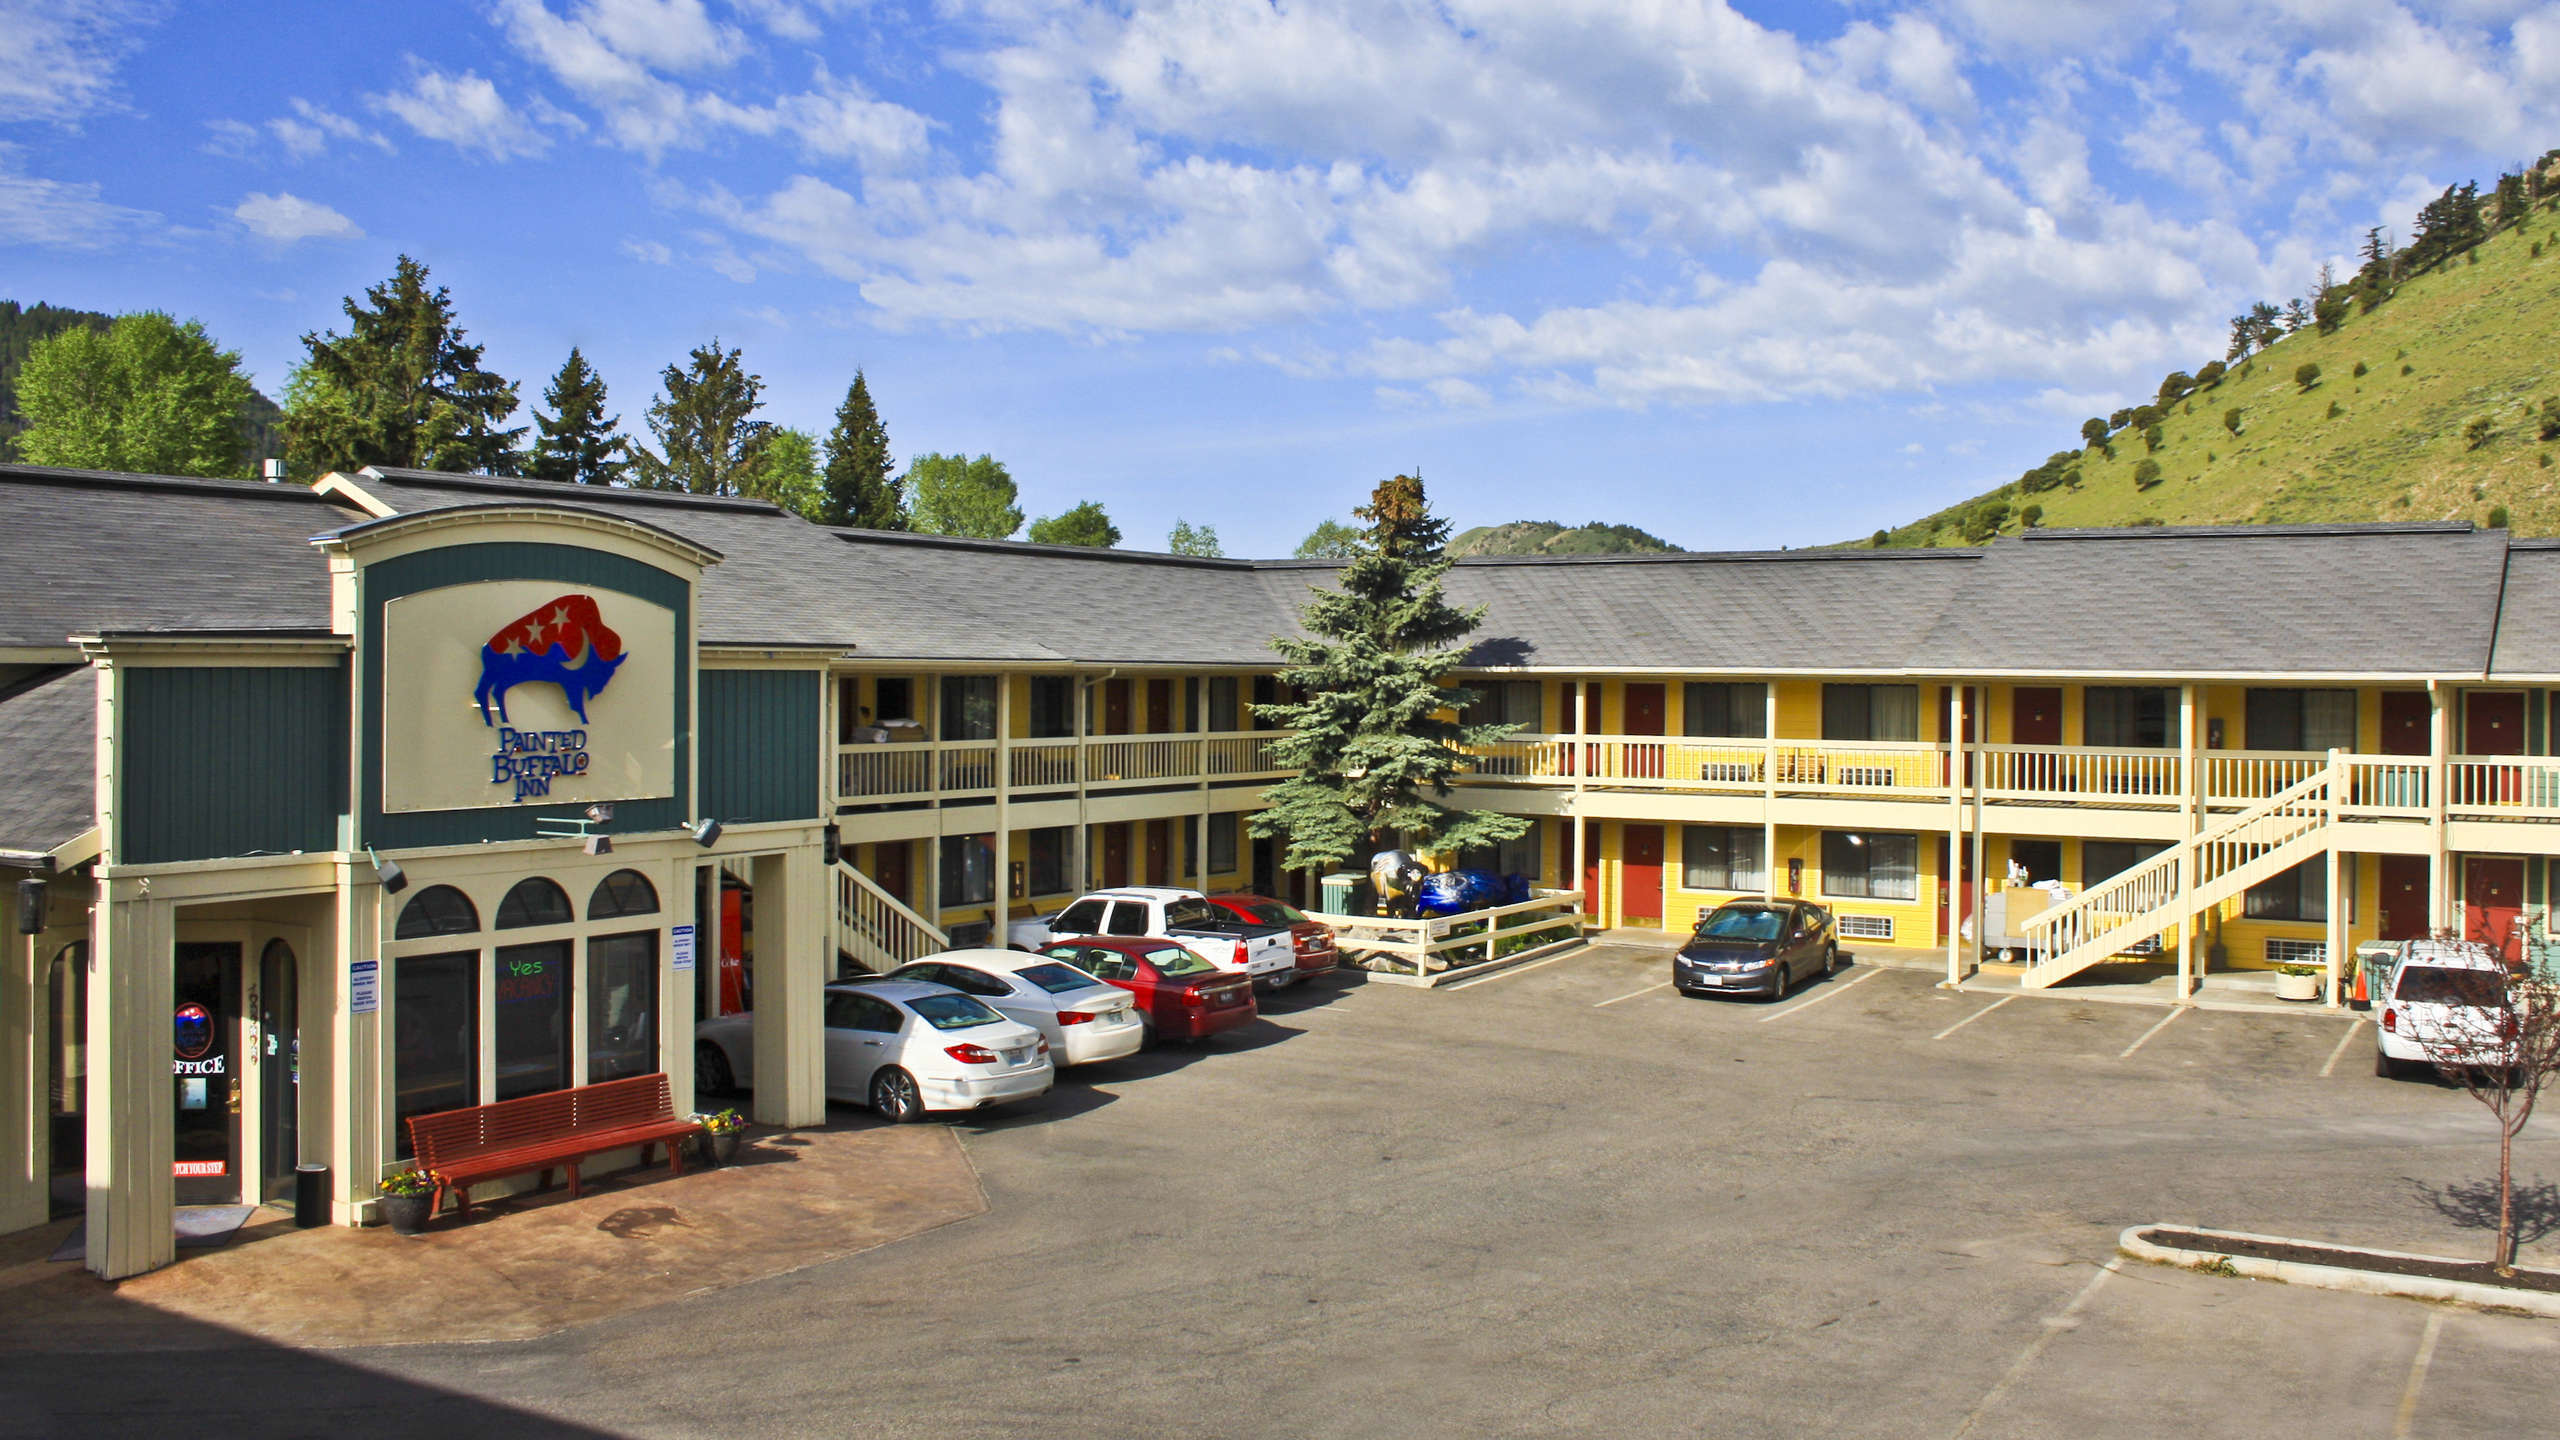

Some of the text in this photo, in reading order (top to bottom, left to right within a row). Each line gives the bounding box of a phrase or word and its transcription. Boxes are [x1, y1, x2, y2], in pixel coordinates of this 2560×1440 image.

[498, 727, 587, 753] PAINTED
[491, 752, 590, 784] BUFFALO
[513, 775, 552, 802] INN
[509, 960, 543, 976] Yes
[172, 1055, 225, 1074] FFICE
[175, 1163, 189, 1174] TCH
